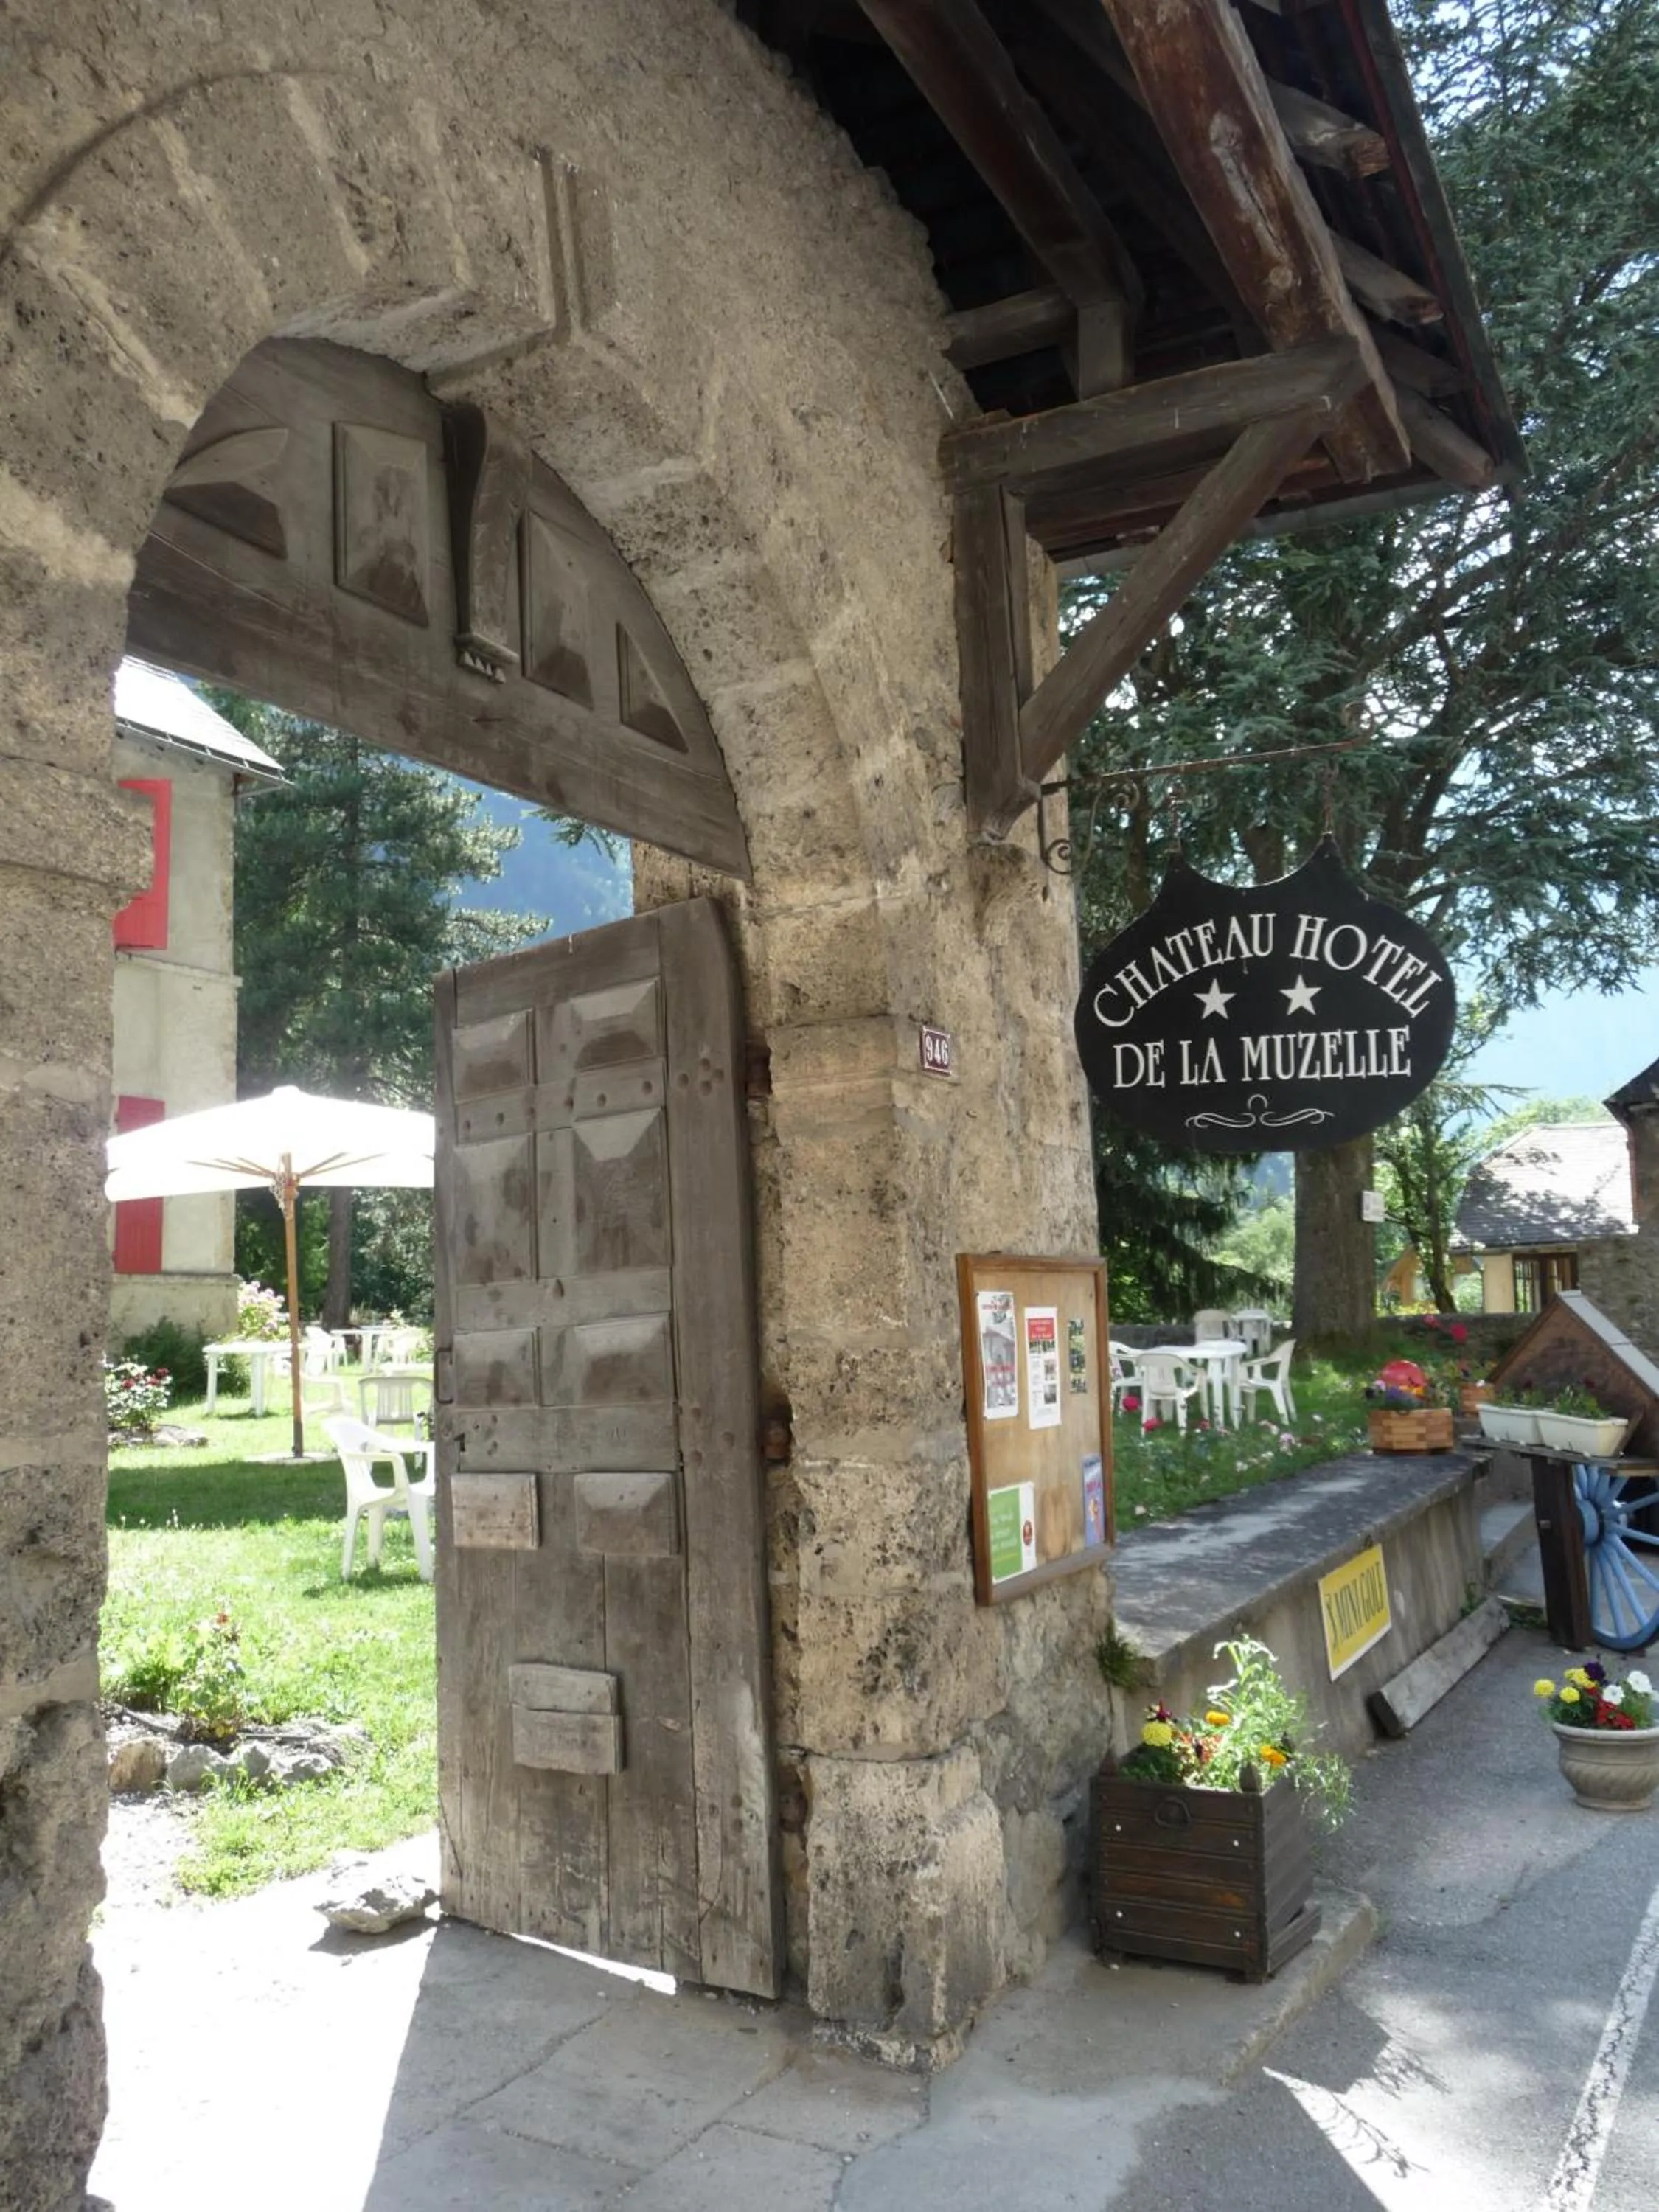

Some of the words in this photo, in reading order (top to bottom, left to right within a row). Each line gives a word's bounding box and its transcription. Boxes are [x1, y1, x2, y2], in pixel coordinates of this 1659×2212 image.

[1093, 913, 1277, 1027] CHATEAU
[1290, 914, 1442, 1018] HOTEL
[925, 1034, 949, 1065] 946
[1113, 1039, 1165, 1088] DE
[1180, 1037, 1226, 1085] LA
[1240, 1025, 1411, 1082] MUZELLE
